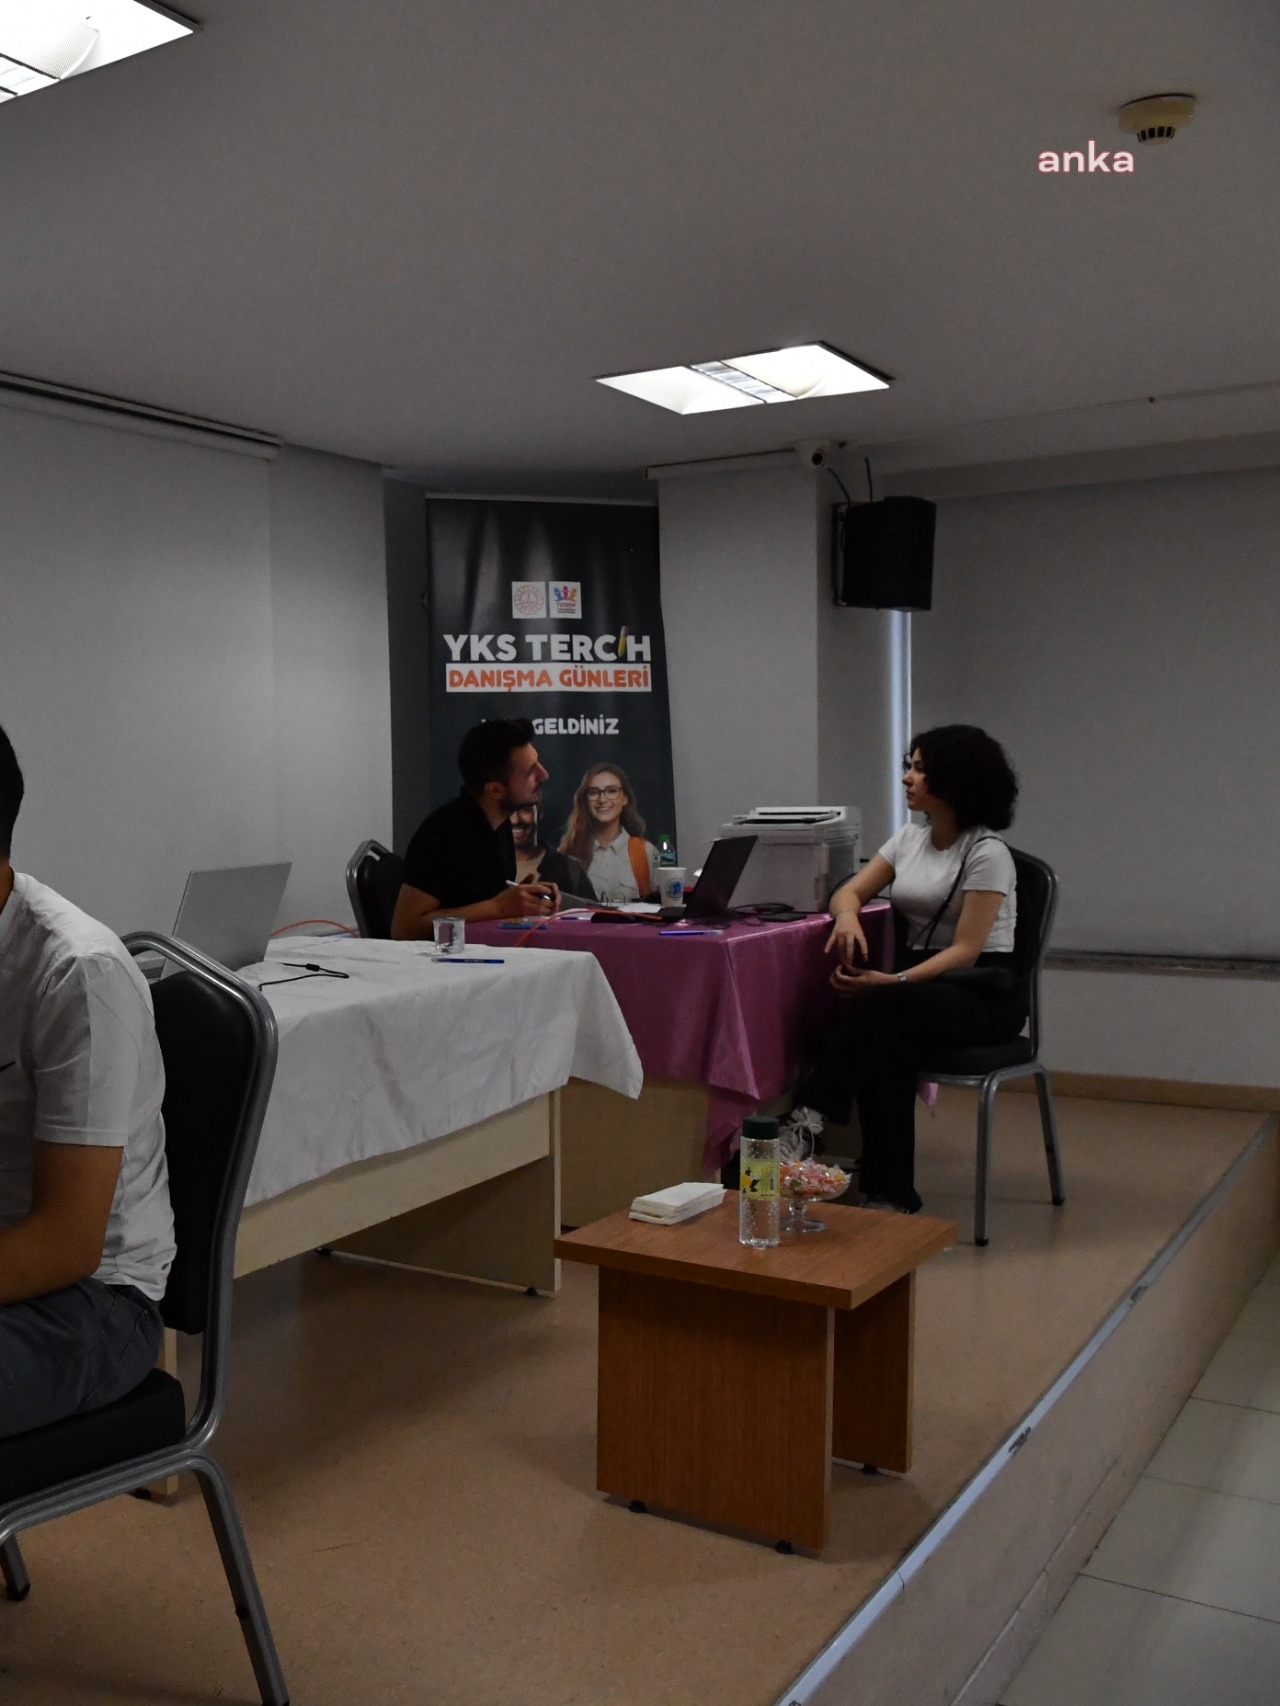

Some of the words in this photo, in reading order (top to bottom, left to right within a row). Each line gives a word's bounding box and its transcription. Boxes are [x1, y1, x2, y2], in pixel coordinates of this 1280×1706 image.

[443, 634, 517, 661] YKS
[449, 669, 553, 692] DANIŞMA
[558, 665, 649, 688] GÜNLERİ
[531, 714, 620, 735] GELDİNİZ
